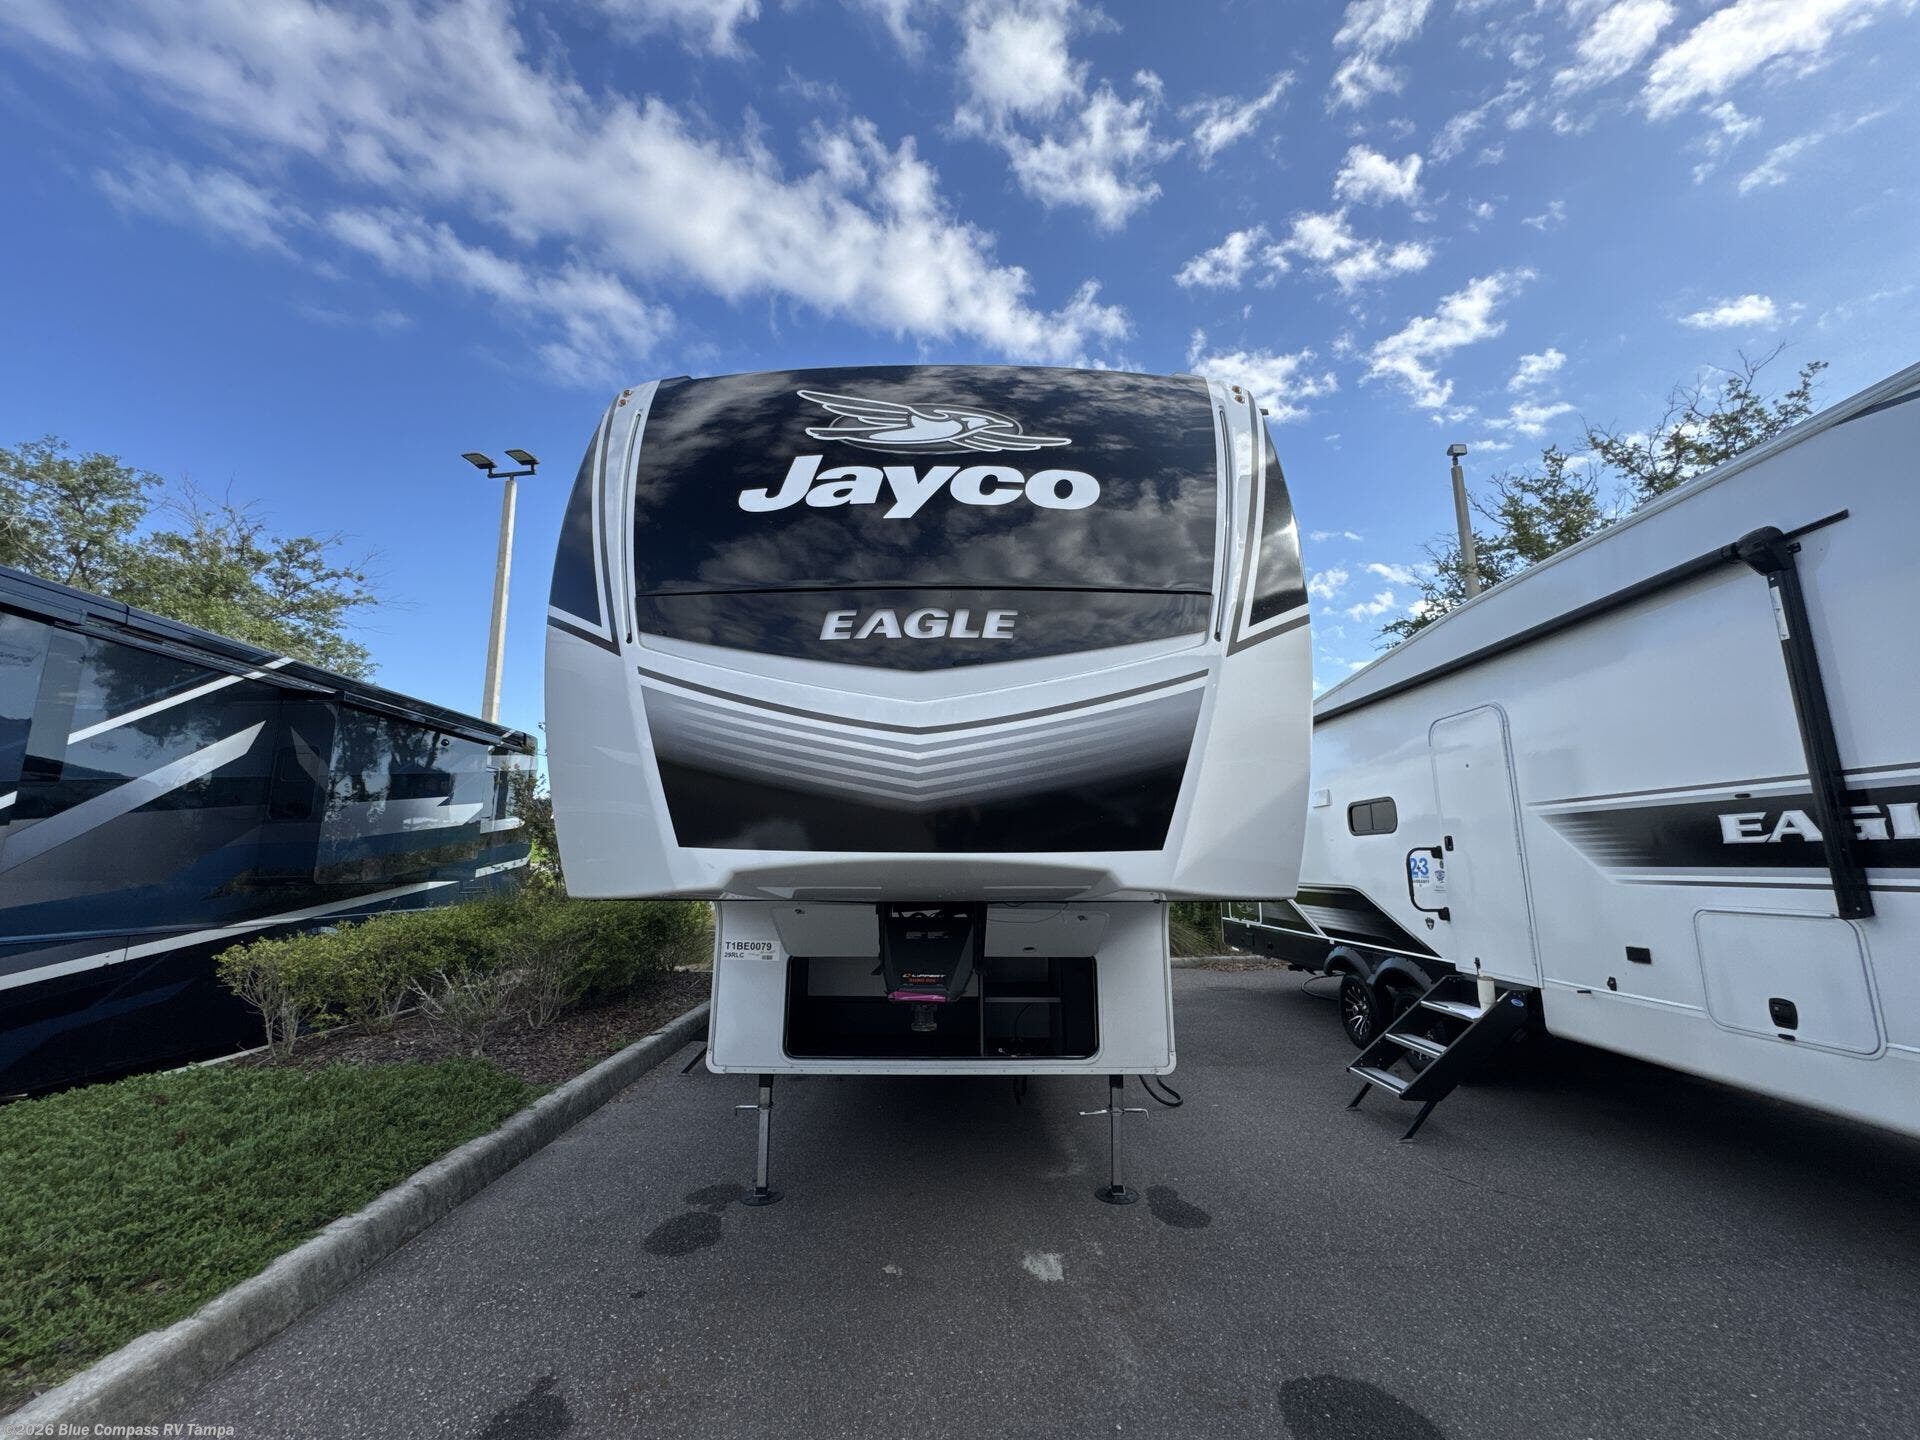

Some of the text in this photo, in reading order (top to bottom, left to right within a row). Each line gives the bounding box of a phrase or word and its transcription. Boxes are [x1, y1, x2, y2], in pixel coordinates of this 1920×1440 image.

[738, 454, 1101, 519] Jayco
[819, 607, 1019, 641] EAGLE
[725, 941, 772, 951] T1BE0079
